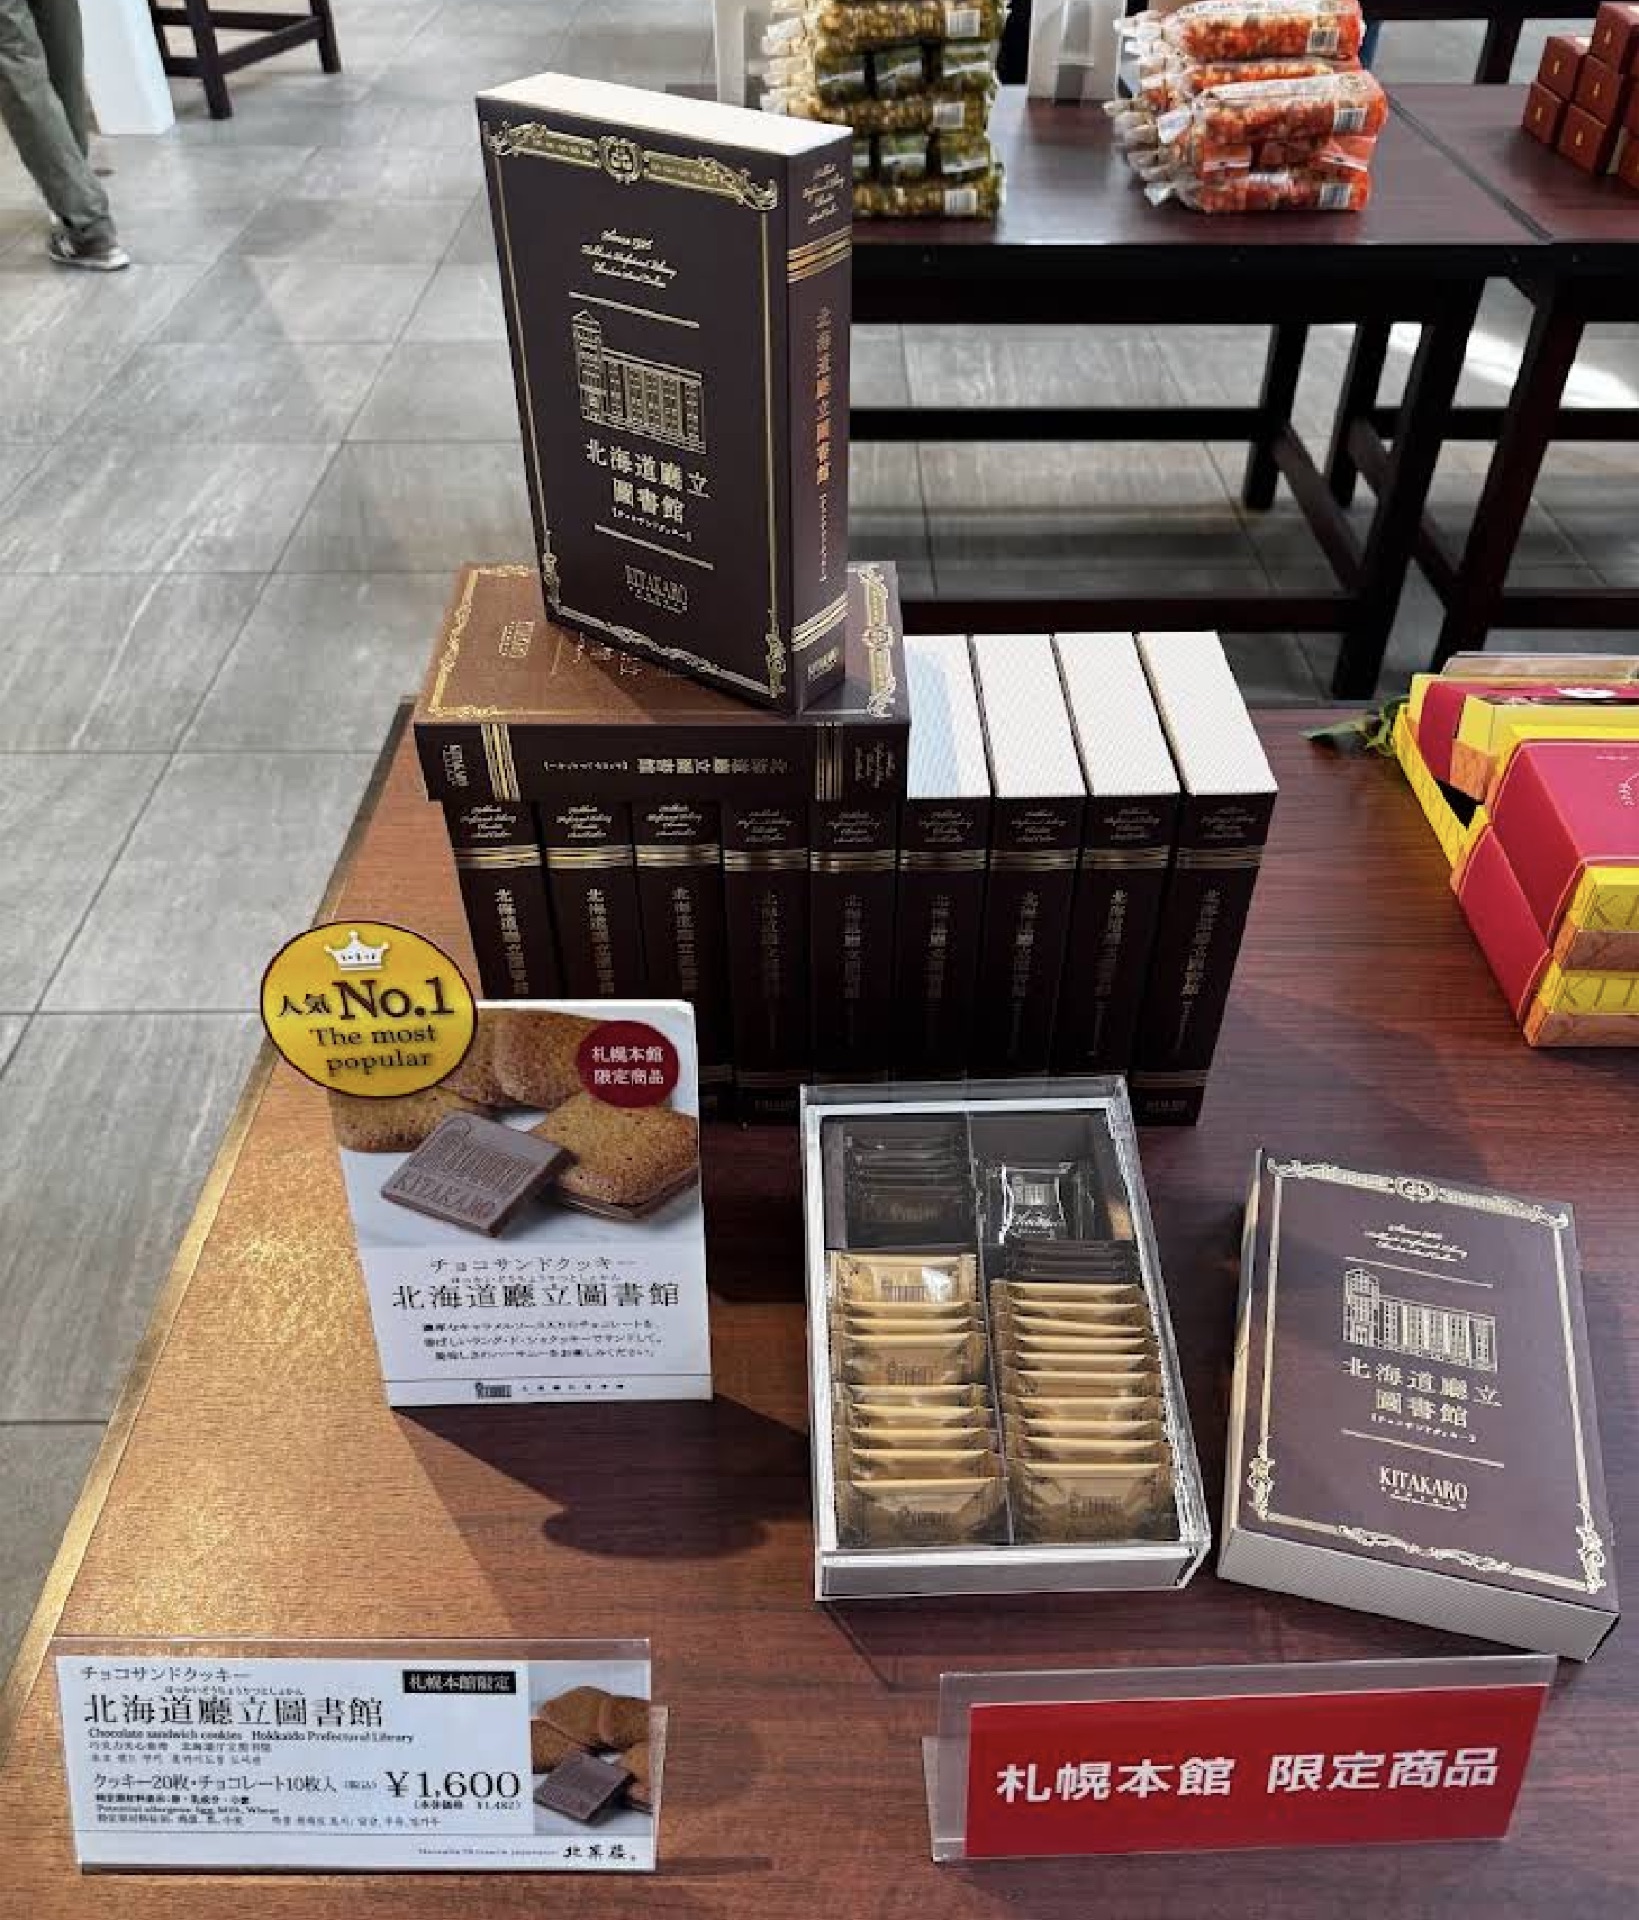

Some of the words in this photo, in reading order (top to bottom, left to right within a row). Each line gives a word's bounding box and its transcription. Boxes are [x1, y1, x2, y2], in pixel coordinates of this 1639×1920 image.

[280, 992, 332, 1016] 人気
[333, 976, 454, 1021] No.1
[309, 1026, 363, 1047] The
[371, 1023, 437, 1045] most
[326, 1049, 433, 1077] popular
[591, 1045, 665, 1064] 札幌本館
[593, 1068, 665, 1086] 限定商品
[429, 1256, 638, 1271] チョコサンドクッキー
[392, 1282, 679, 1309] 北海道廳立圖書館
[1379, 1465, 1469, 1503] KITAKARO
[80, 1665, 251, 1683] チョコサンドクッキー
[84, 1694, 383, 1728] 北海道廳立圖書館
[88, 1728, 144, 1740] Chocolate
[146, 1729, 198, 1740] sandwich
[201, 1729, 243, 1740] cookies
[252, 1730, 306, 1741] Hokkaido
[308, 1731, 369, 1743] Prefectural
[372, 1731, 415, 1744] Library
[385, 1770, 521, 1799] ¥1,600
[996, 1756, 1236, 1804] 札幌本館
[1266, 1746, 1500, 1795] 限定商品
